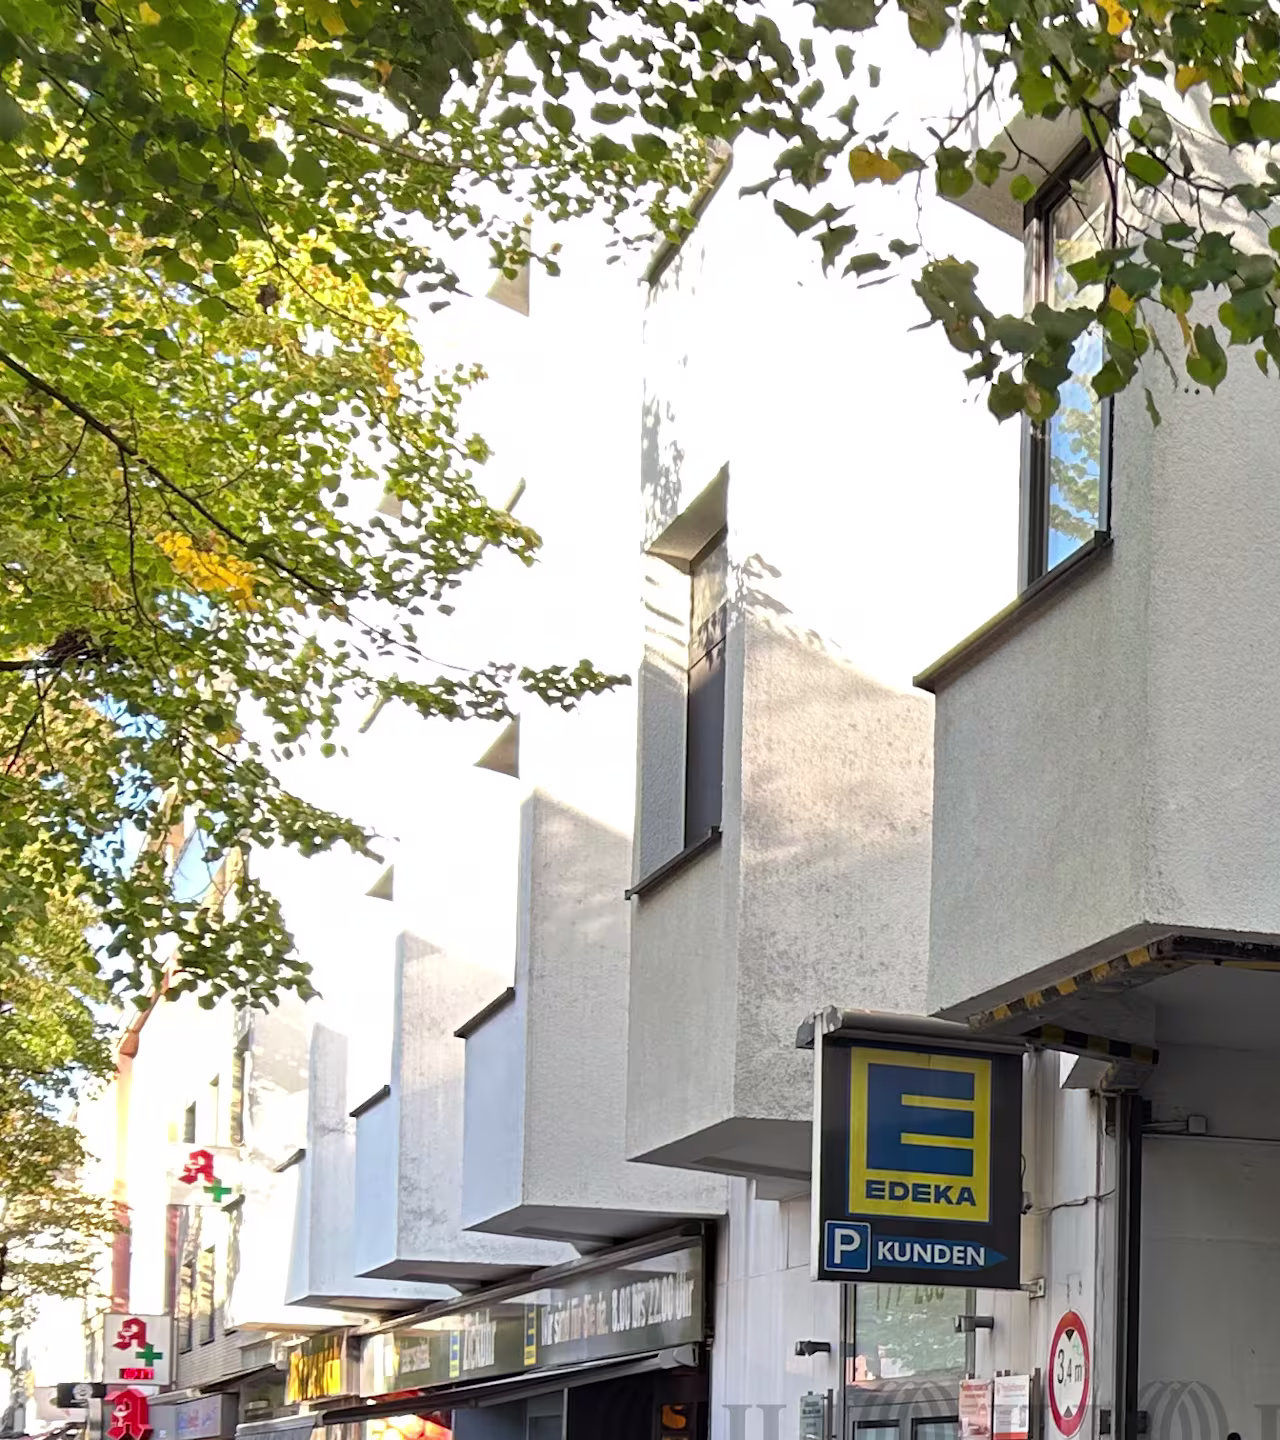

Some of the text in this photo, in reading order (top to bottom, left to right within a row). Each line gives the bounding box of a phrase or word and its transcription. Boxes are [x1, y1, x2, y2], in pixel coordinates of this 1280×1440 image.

[865, 1179, 977, 1207] EDEKA
[833, 1227, 986, 1267] P KUNDEN
[1057, 1349, 1072, 1387] 3,4
